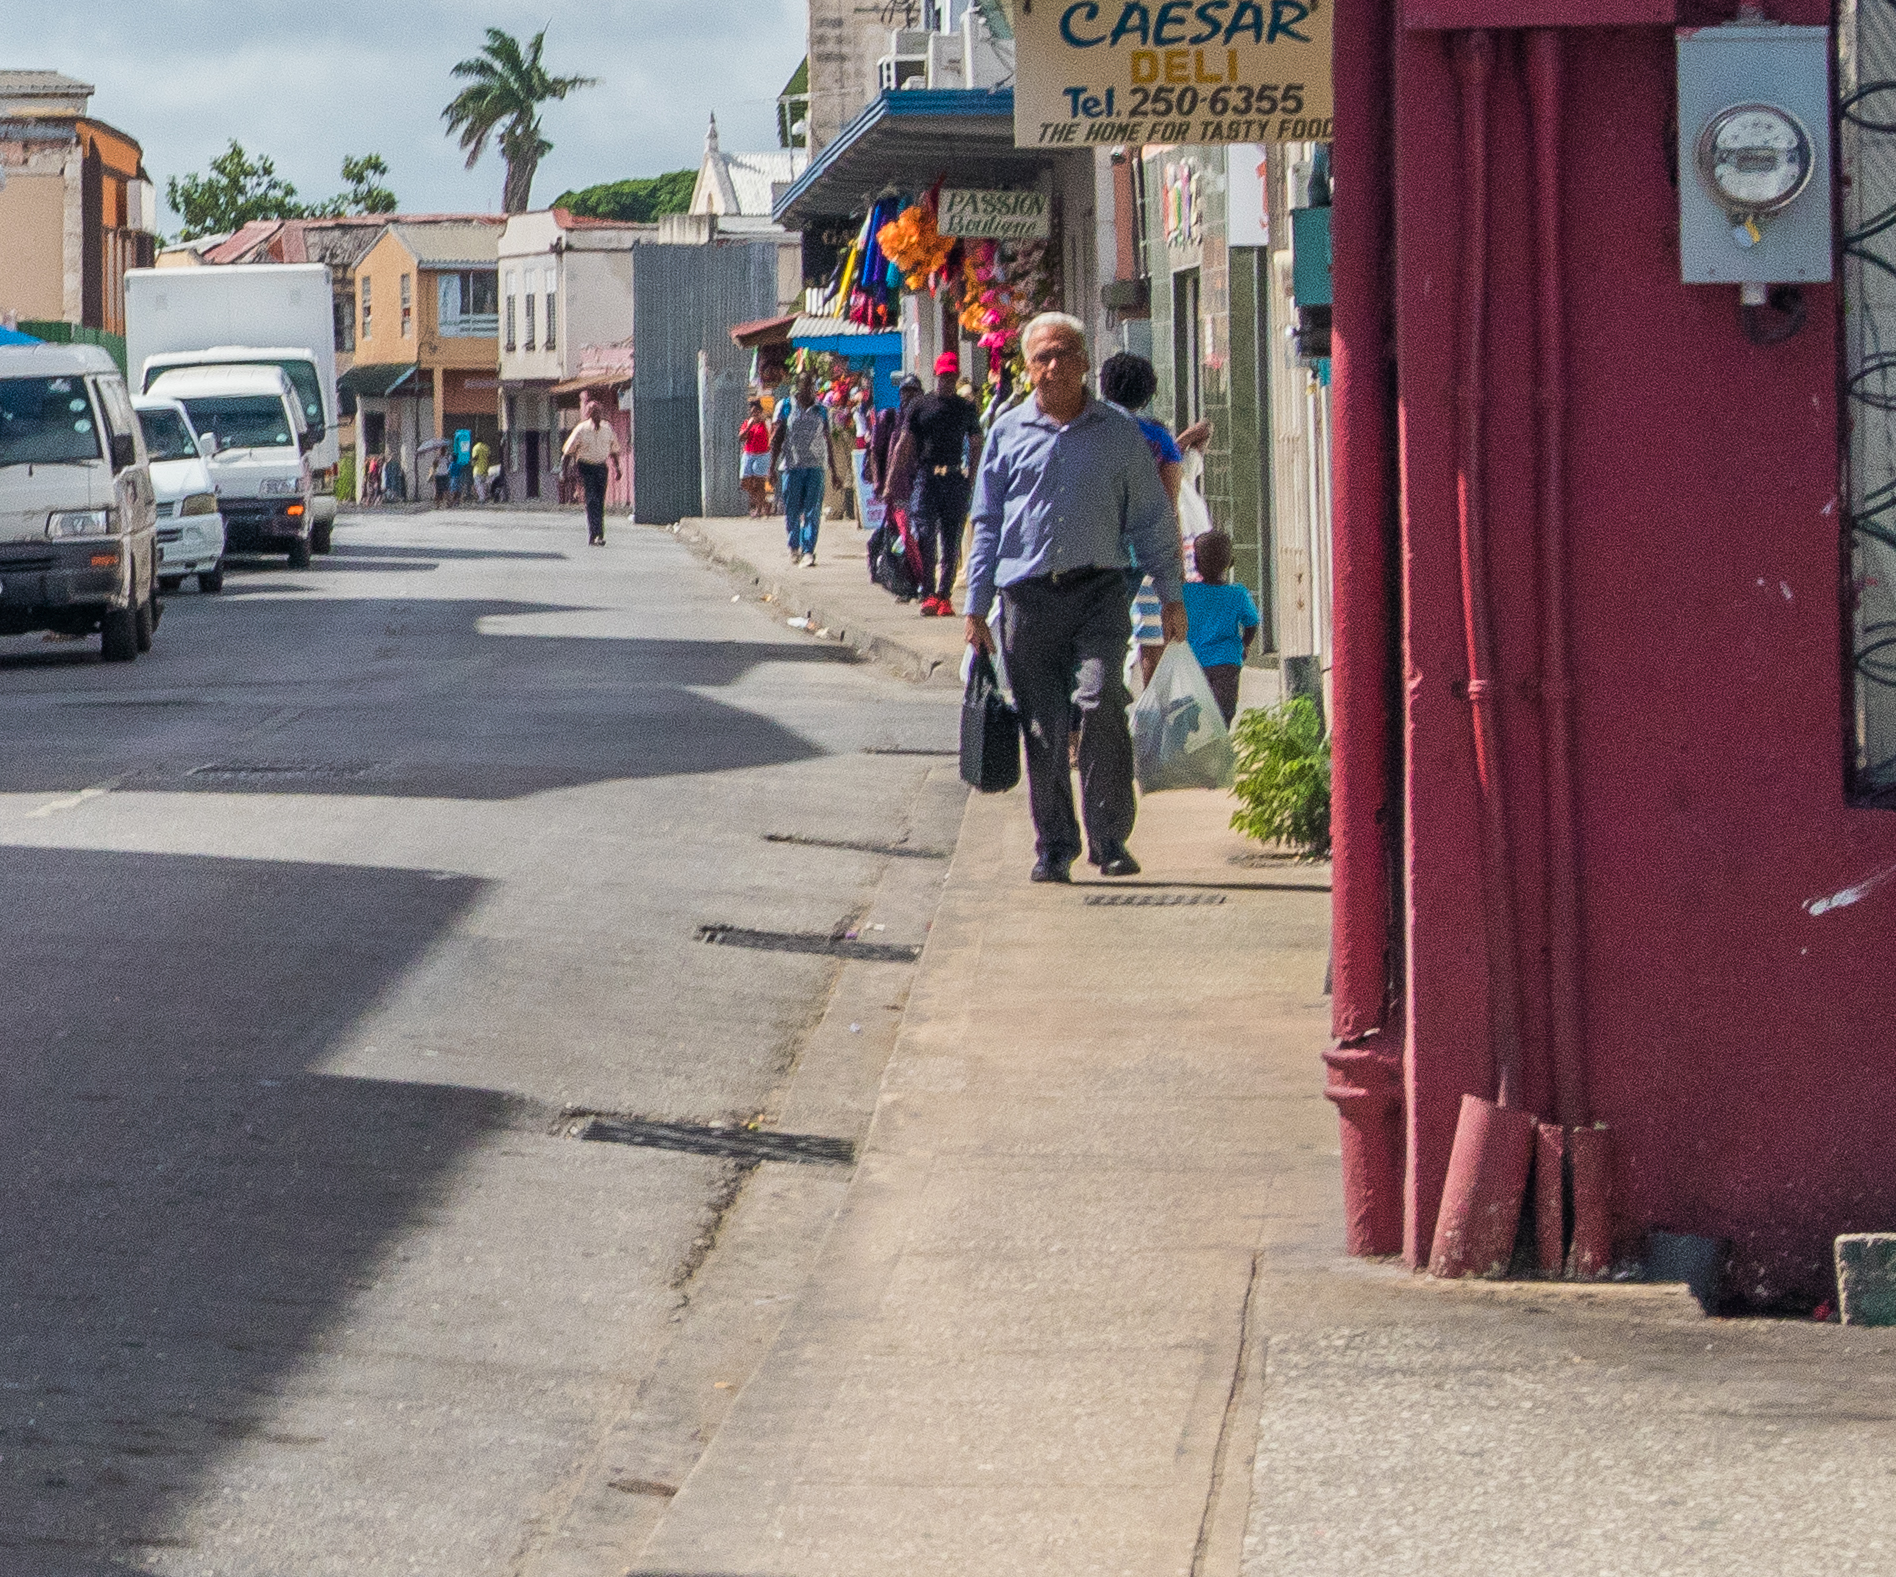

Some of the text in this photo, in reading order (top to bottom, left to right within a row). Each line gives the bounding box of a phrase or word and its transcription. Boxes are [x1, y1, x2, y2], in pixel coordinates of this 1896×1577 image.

[1059, 0, 1311, 48] CAESAR
[1130, 49, 1238, 85] DELI
[1063, 84, 1303, 118] Tel. 250-6355
[1038, 122, 1080, 143] THE
[1084, 121, 1139, 143] HOME
[1146, 120, 1191, 142] FOR
[1199, 119, 1270, 141] TASTY
[946, 191, 1048, 216] PASSION
